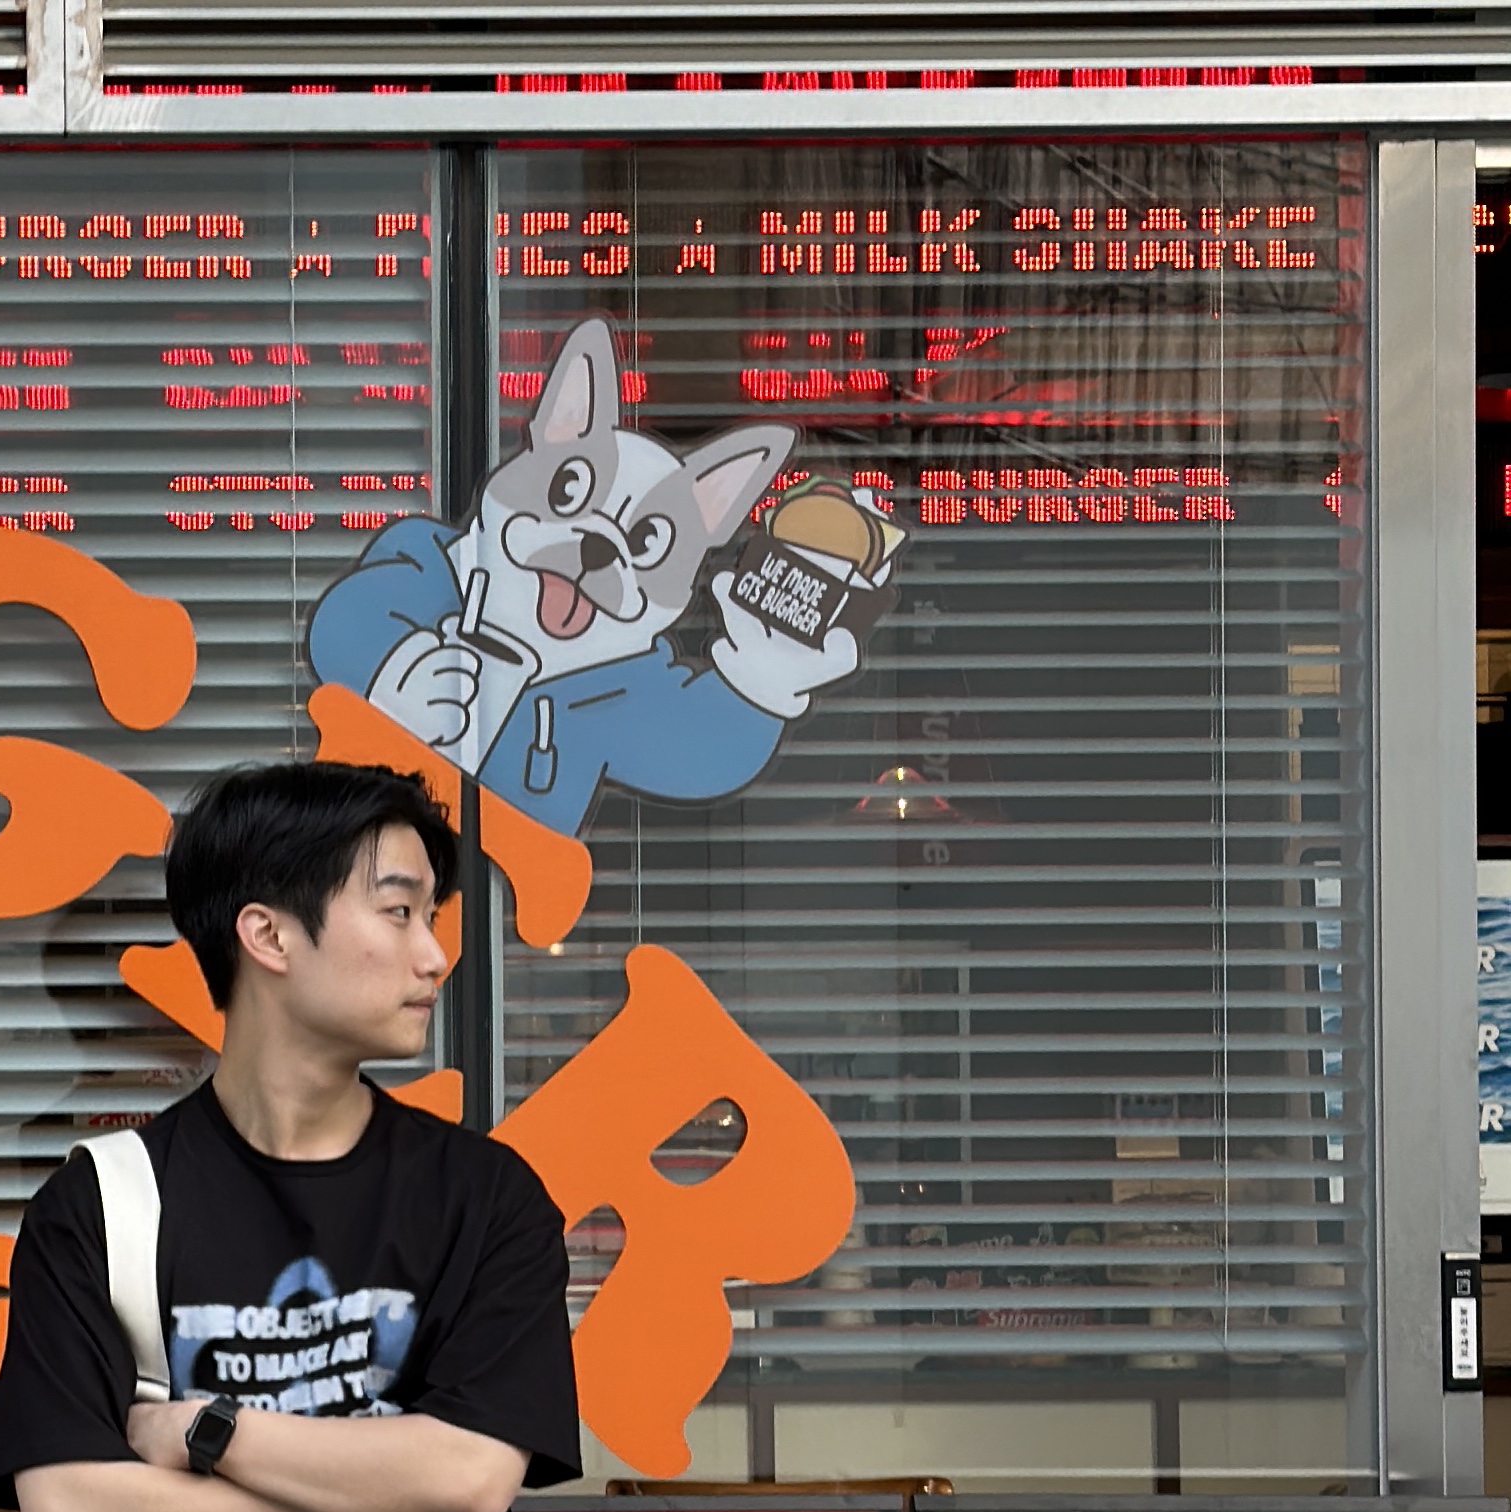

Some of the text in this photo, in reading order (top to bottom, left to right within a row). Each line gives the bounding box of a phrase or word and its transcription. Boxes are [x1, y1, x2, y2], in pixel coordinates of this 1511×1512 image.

[759, 208, 981, 276] MILK
[920, 466, 1236, 524] BURGER
[737, 570, 766, 604] GTS
[760, 551, 828, 608] WE MADE
[172, 1303, 235, 1339] THE
[236, 1298, 337, 1340] OBJECT
[213, 1350, 251, 1382] TO
[255, 1342, 330, 1382] MAKE
